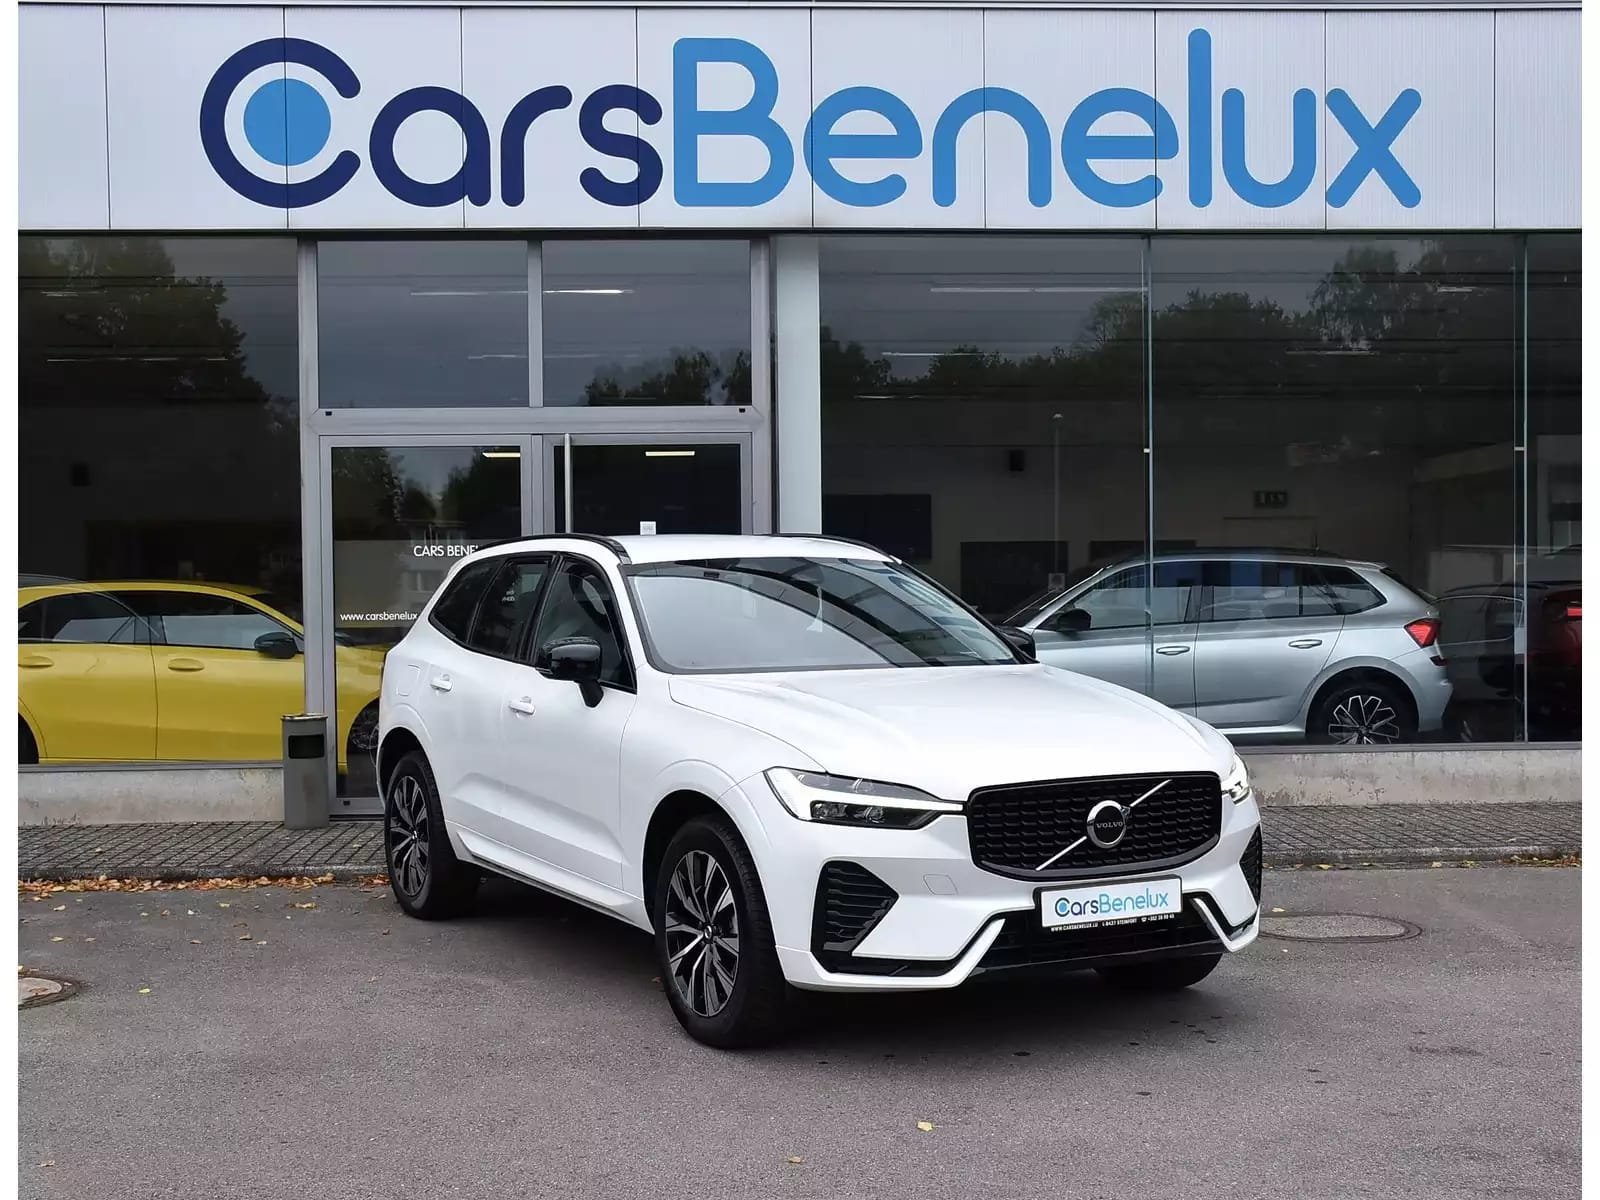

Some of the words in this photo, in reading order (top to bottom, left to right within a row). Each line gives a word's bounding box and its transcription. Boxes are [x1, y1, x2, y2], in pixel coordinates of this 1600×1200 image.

[200, 29, 1421, 208] CarsBenelux
[413, 545, 445, 557] CARS
[447, 545, 479, 557] BENE
[1096, 821, 1124, 829] VOLVO
[1054, 888, 1169, 918] CarsBenelux
